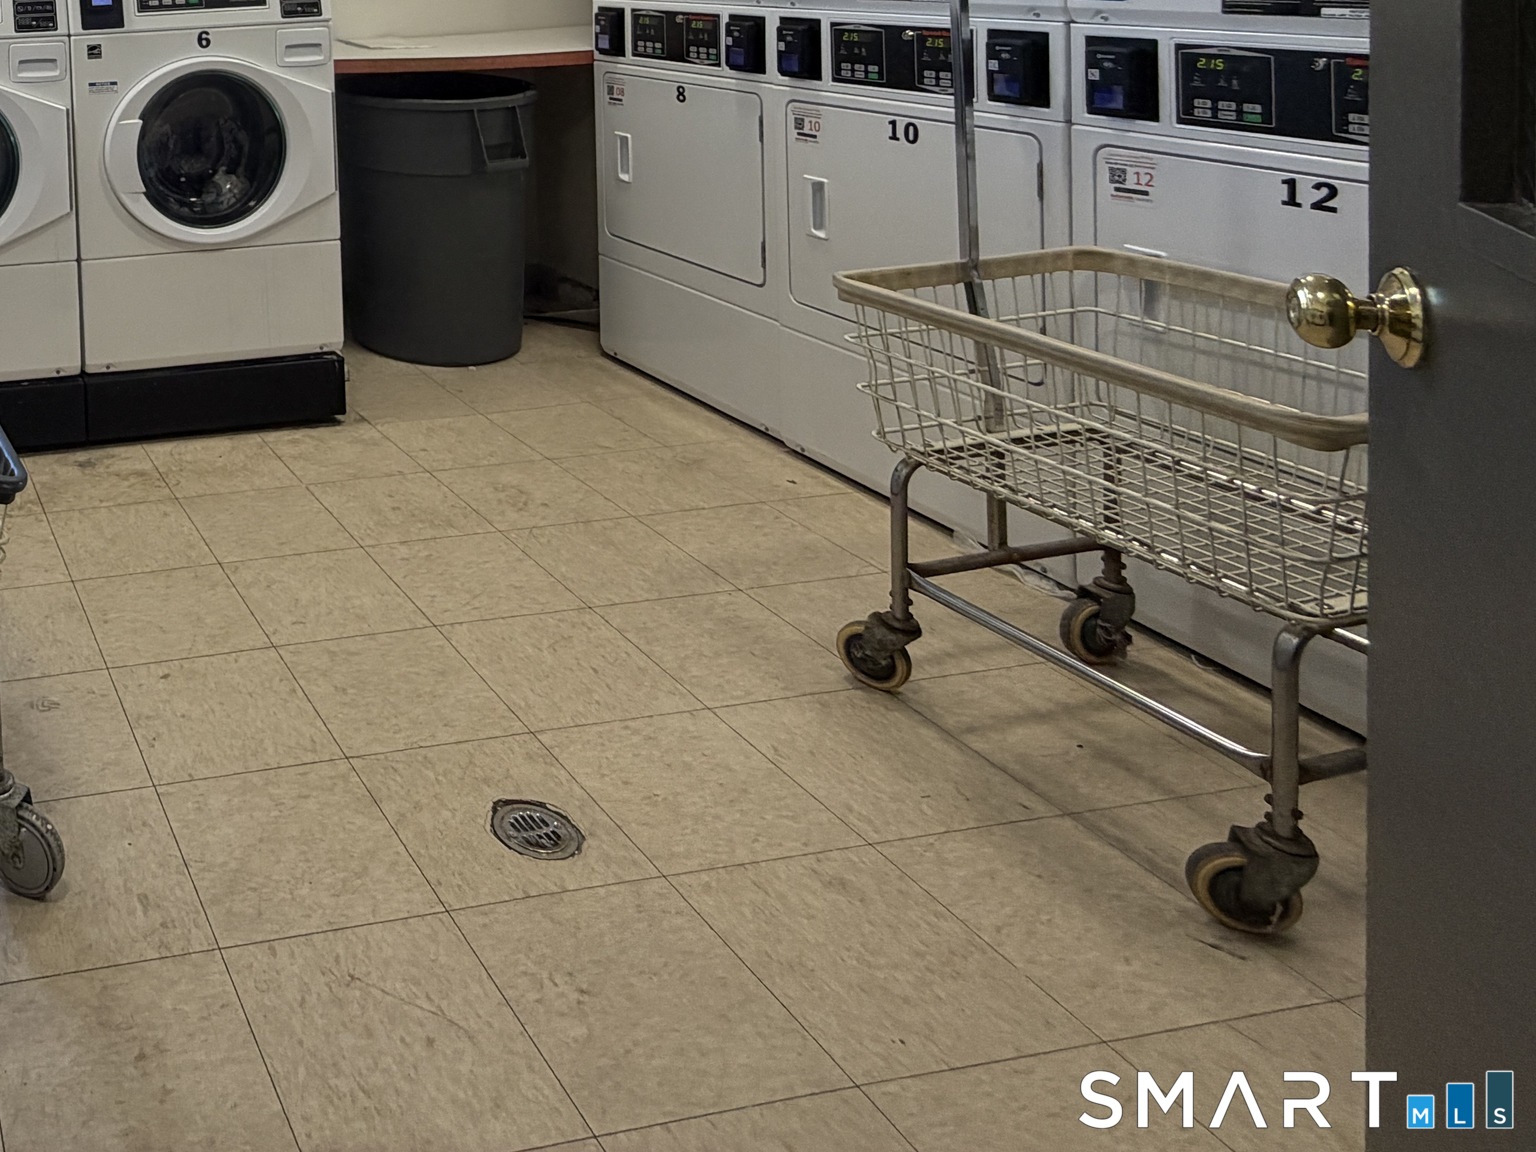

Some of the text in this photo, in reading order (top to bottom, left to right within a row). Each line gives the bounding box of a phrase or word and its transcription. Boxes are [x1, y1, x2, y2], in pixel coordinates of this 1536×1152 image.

[197, 30, 211, 48] 6
[615, 86, 625, 98] 08
[676, 86, 687, 103] 8
[807, 120, 821, 132] 10
[887, 119, 920, 145] 10
[1133, 171, 1155, 188] 12
[1280, 177, 1339, 213] 12
